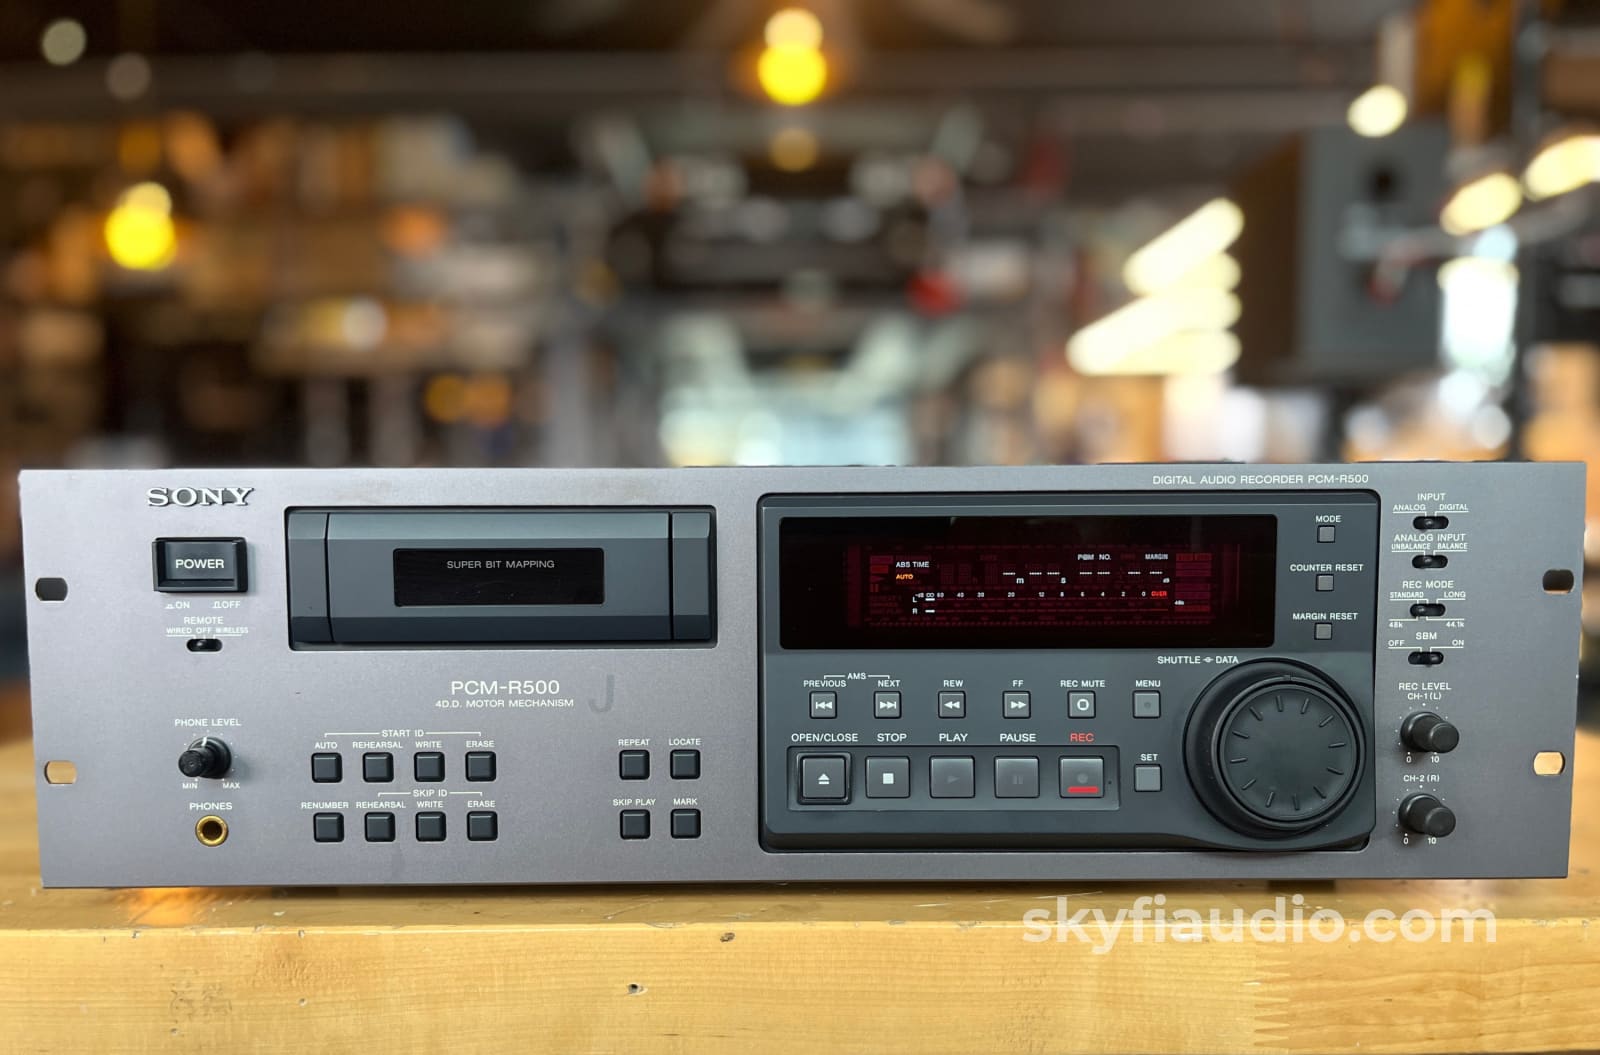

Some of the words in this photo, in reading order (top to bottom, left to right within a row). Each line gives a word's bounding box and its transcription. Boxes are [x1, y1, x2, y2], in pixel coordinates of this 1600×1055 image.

[1152, 476, 1195, 485] DIGITAL
[1200, 475, 1236, 484] AUDIO
[1240, 475, 1304, 484] RECORDER
[1308, 474, 1369, 484] PCM-R500
[146, 487, 254, 506] SONY
[1417, 493, 1446, 501] INPUT
[1315, 515, 1341, 523] MODE
[1394, 534, 1433, 542] ANALOG
[175, 558, 225, 569] POWER
[447, 561, 482, 569] SUPER
[506, 560, 555, 568] MAPPING
[1290, 564, 1332, 572] COUNTER
[1335, 564, 1364, 572] RESET
[175, 601, 190, 609] ON
[222, 600, 241, 609] OFF
[184, 616, 224, 625] REMOTE
[166, 626, 192, 634] WIRED
[196, 626, 211, 634] OFF
[215, 626, 249, 634] WIRELESS
[1416, 632, 1437, 640] SBM
[1157, 656, 1201, 664] SHUTTLE
[1215, 656, 1239, 664] DATA
[847, 672, 867, 680] AMS
[451, 680, 560, 695] PCM-R500
[803, 680, 846, 688] PREVIOUS
[878, 680, 900, 688] NEXT
[943, 680, 964, 688] REW
[1013, 680, 1024, 688] FF
[1060, 680, 1080, 688] REC
[1082, 680, 1105, 688] MUTE
[1136, 680, 1161, 688] MENU
[1399, 682, 1418, 691] REC
[1422, 682, 1451, 690] LEVEL
[435, 700, 462, 708] 4D.D.
[466, 700, 505, 708] MOTOR
[508, 699, 574, 708] MECHANISM
[175, 719, 208, 727] PHONE
[212, 718, 241, 726] LEVEL
[381, 729, 409, 737] START
[414, 729, 424, 737] ID
[791, 733, 858, 742] OPEN/CLOSE
[877, 733, 907, 742] STOP
[939, 733, 968, 742] PLAY
[1000, 733, 1036, 742] PAUSE
[1070, 733, 1094, 742] REC
[315, 741, 337, 749] AUTO
[352, 741, 403, 749] REHEARSAL
[415, 740, 442, 749] WRITE
[466, 740, 495, 748] ERASE
[618, 738, 650, 746] REPEAT
[669, 738, 702, 746] LOCATE
[1140, 754, 1158, 762] SET
[413, 789, 433, 797] SKIP
[437, 789, 447, 797] ID
[190, 802, 233, 810] PHONES
[301, 801, 349, 809] RENUMBER
[356, 801, 407, 809] REHEARSAL
[417, 800, 444, 808] WRITE
[467, 800, 496, 808] ERASE
[613, 798, 632, 806] SKIP
[635, 798, 656, 806] PLAY
[673, 798, 698, 806] MARK
